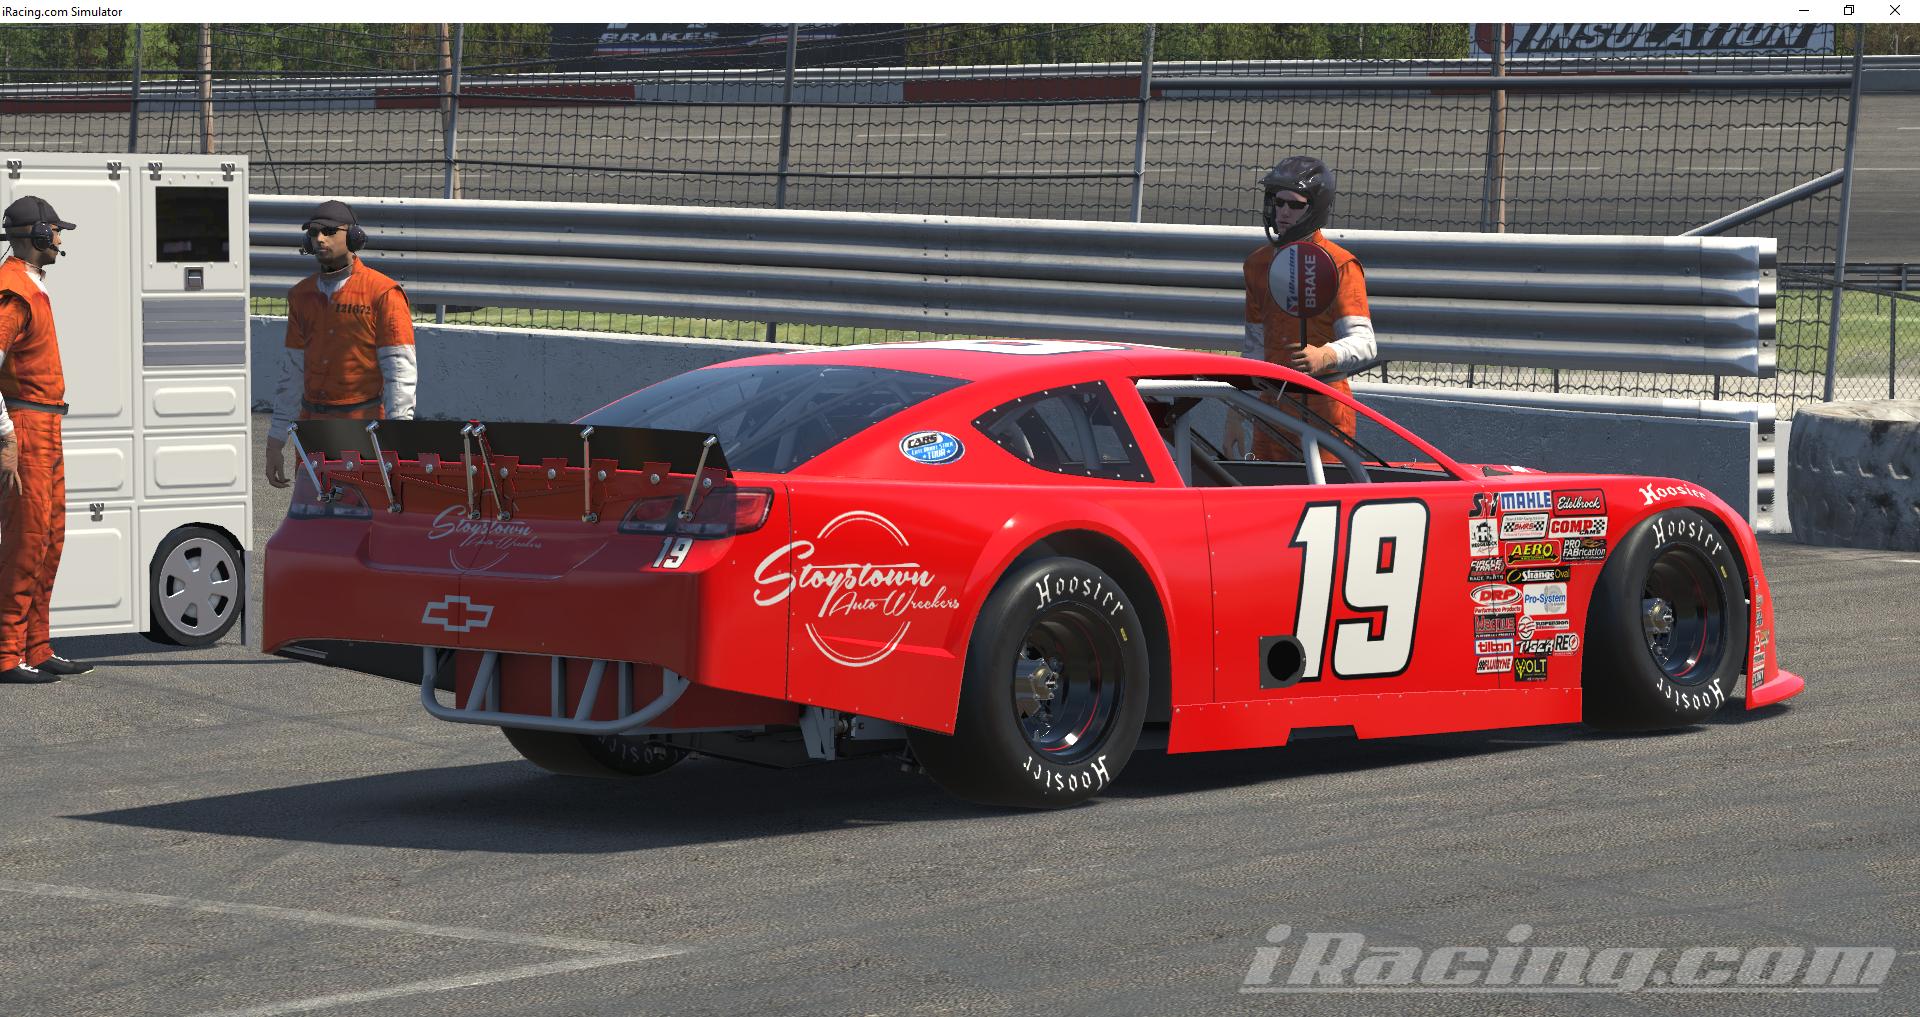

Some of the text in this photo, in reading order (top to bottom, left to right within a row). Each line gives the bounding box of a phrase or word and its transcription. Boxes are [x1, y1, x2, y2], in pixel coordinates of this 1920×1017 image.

[600, 31, 720, 42] BRAKES
[1304, 254, 1317, 309] BRAKE
[1501, 491, 1552, 510] MAHLE
[1639, 483, 1706, 506] Hoosier
[1557, 496, 1601, 510] Edelbrock
[1551, 519, 1593, 534] COMP
[1652, 517, 1722, 555] Hoosier
[1511, 543, 1553, 557] AERO
[1564, 539, 1581, 549] PRO
[651, 536, 694, 569] 19
[1562, 547, 1606, 557] FABrication
[753, 540, 935, 618] Stoystown
[1521, 568, 1570, 581] Strange Oval
[1035, 574, 1124, 615] Hoosier
[1288, 497, 1431, 683] 19
[1479, 588, 1517, 601] DRP
[829, 586, 960, 616] Auto Wreckers
[1524, 592, 1566, 605] Pro-System
[1478, 641, 1512, 653] tilton
[1516, 639, 1554, 654] TIGER
